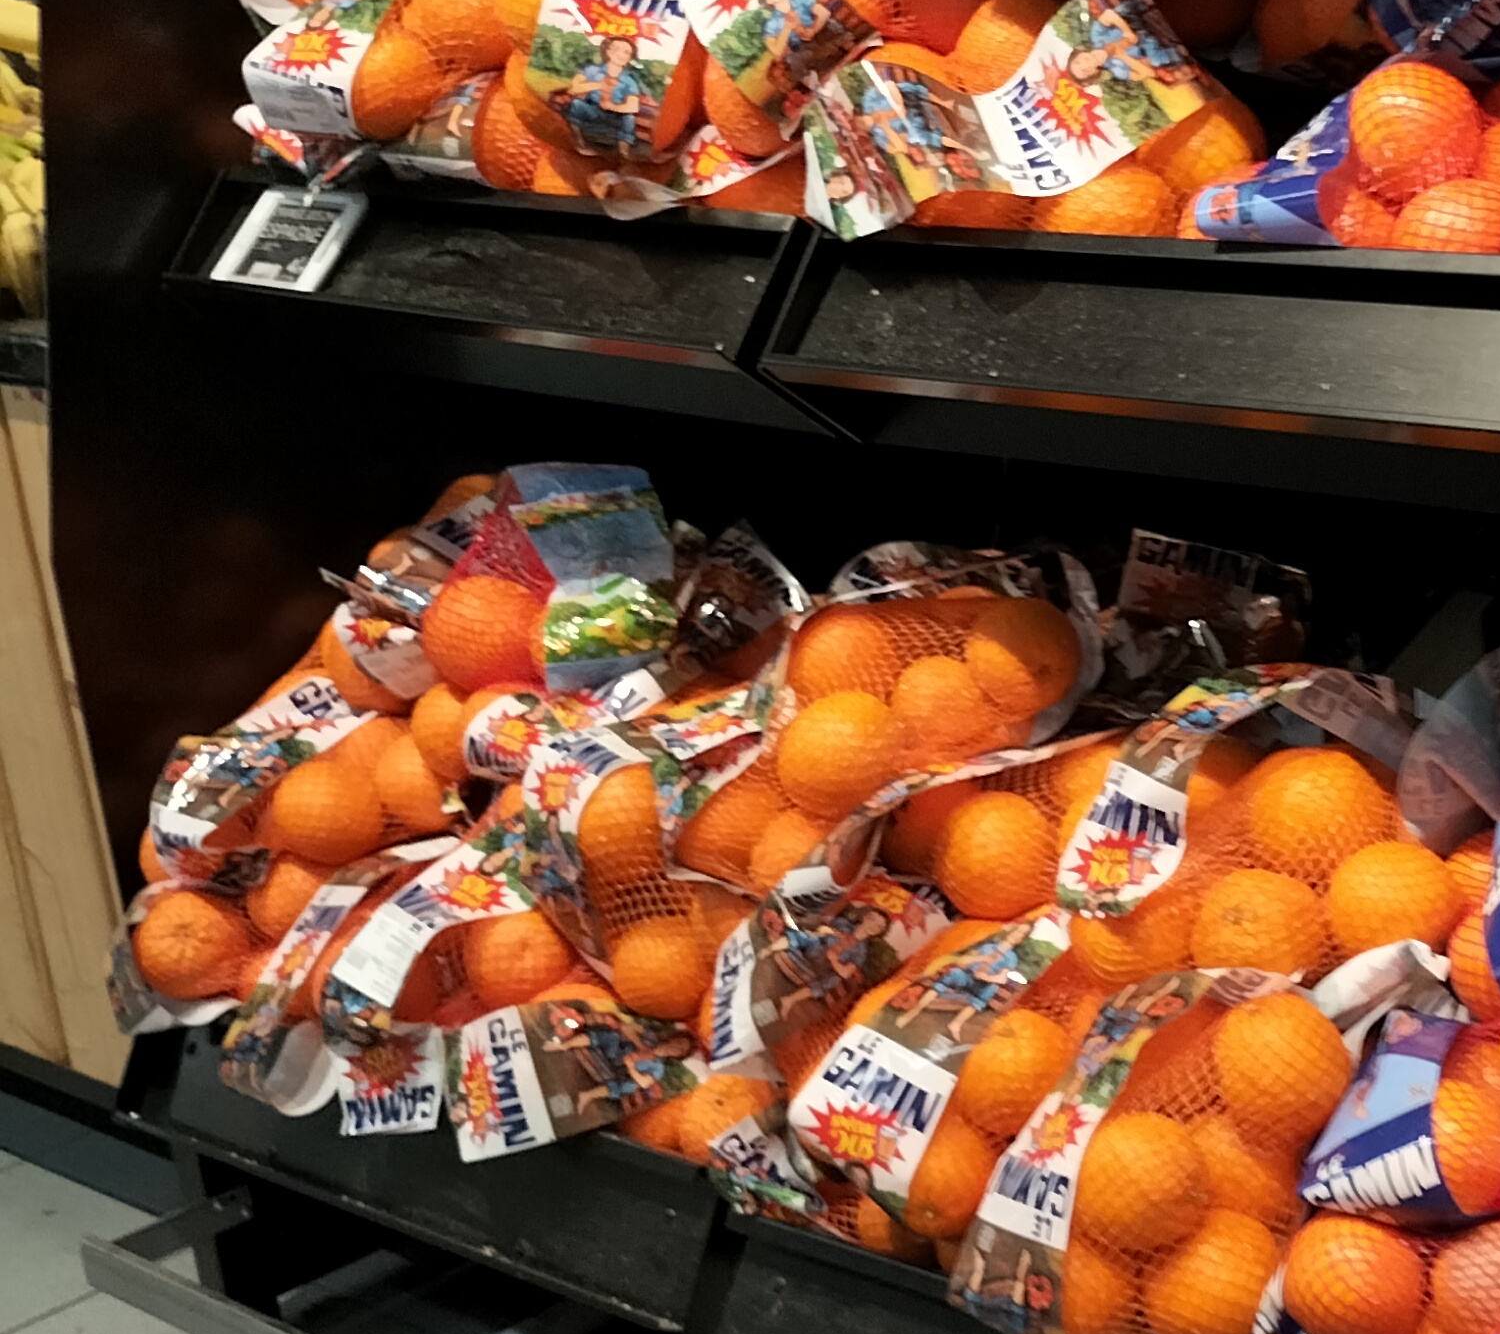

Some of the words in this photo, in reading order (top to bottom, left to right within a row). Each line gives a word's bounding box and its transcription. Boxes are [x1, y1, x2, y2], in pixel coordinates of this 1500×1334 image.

[1002, 76, 1072, 191] GAMIN
[487, 1018, 537, 1147] GAMIN
[509, 1029, 528, 1054] LE
[823, 1046, 943, 1134] GAMIN
[1302, 1134, 1442, 1215] GAMIN
